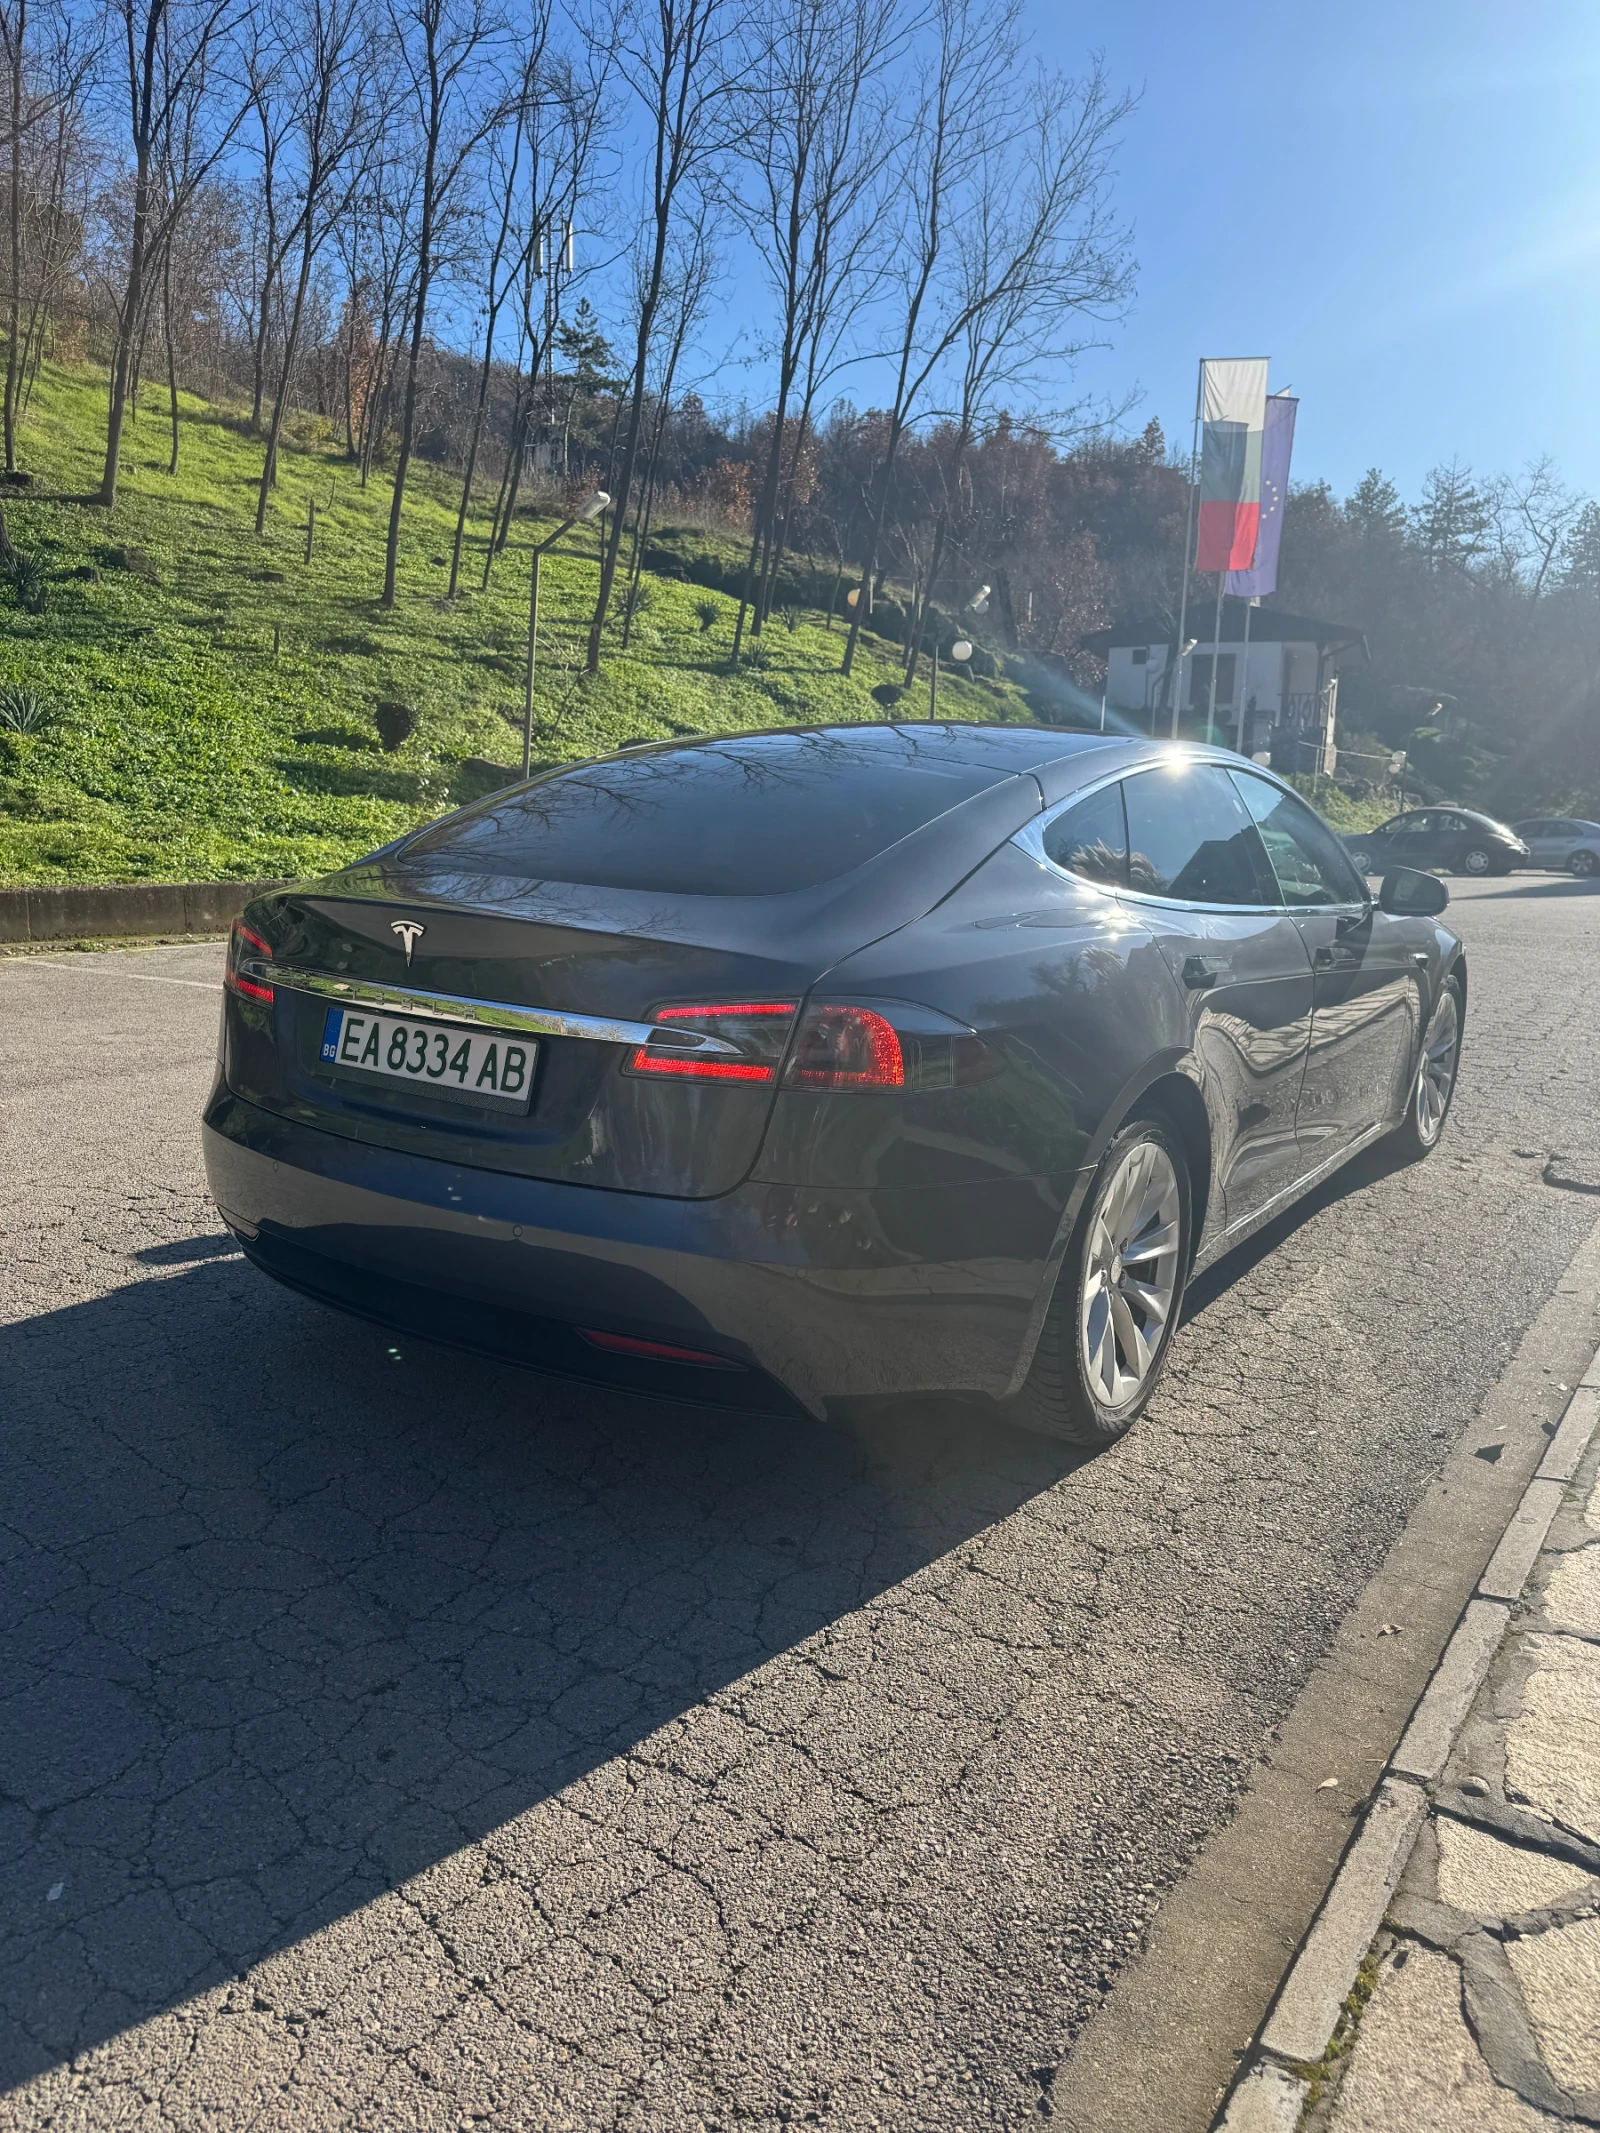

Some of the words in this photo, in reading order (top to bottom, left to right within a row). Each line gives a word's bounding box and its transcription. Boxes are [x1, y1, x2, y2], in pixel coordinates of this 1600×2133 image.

[323, 1043, 336, 1057] BG
[341, 1017, 379, 1067] EA
[387, 1027, 472, 1083] 8334
[475, 1043, 527, 1093] AB
